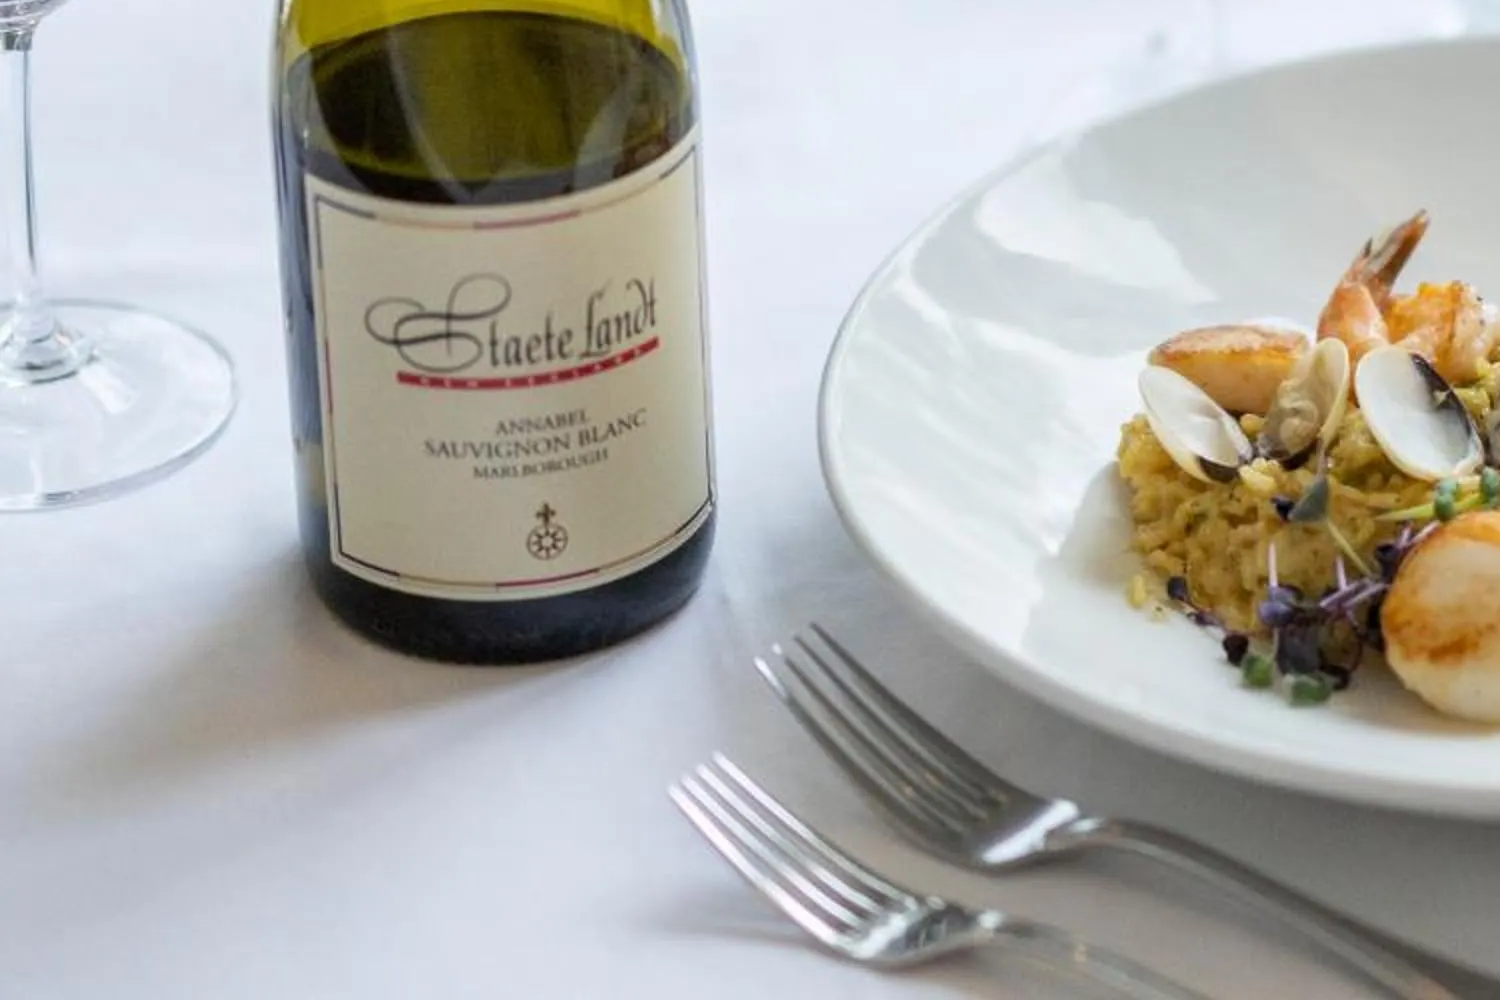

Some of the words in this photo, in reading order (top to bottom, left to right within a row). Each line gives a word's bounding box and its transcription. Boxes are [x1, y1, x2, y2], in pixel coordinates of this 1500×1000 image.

[364, 272, 574, 373] Staete
[579, 277, 657, 358] Landt
[424, 432, 571, 460] SAUVIGNON
[577, 407, 647, 447] BLANC
[496, 408, 590, 436] ANNABEL
[473, 447, 609, 480] MARLBOROUGH
